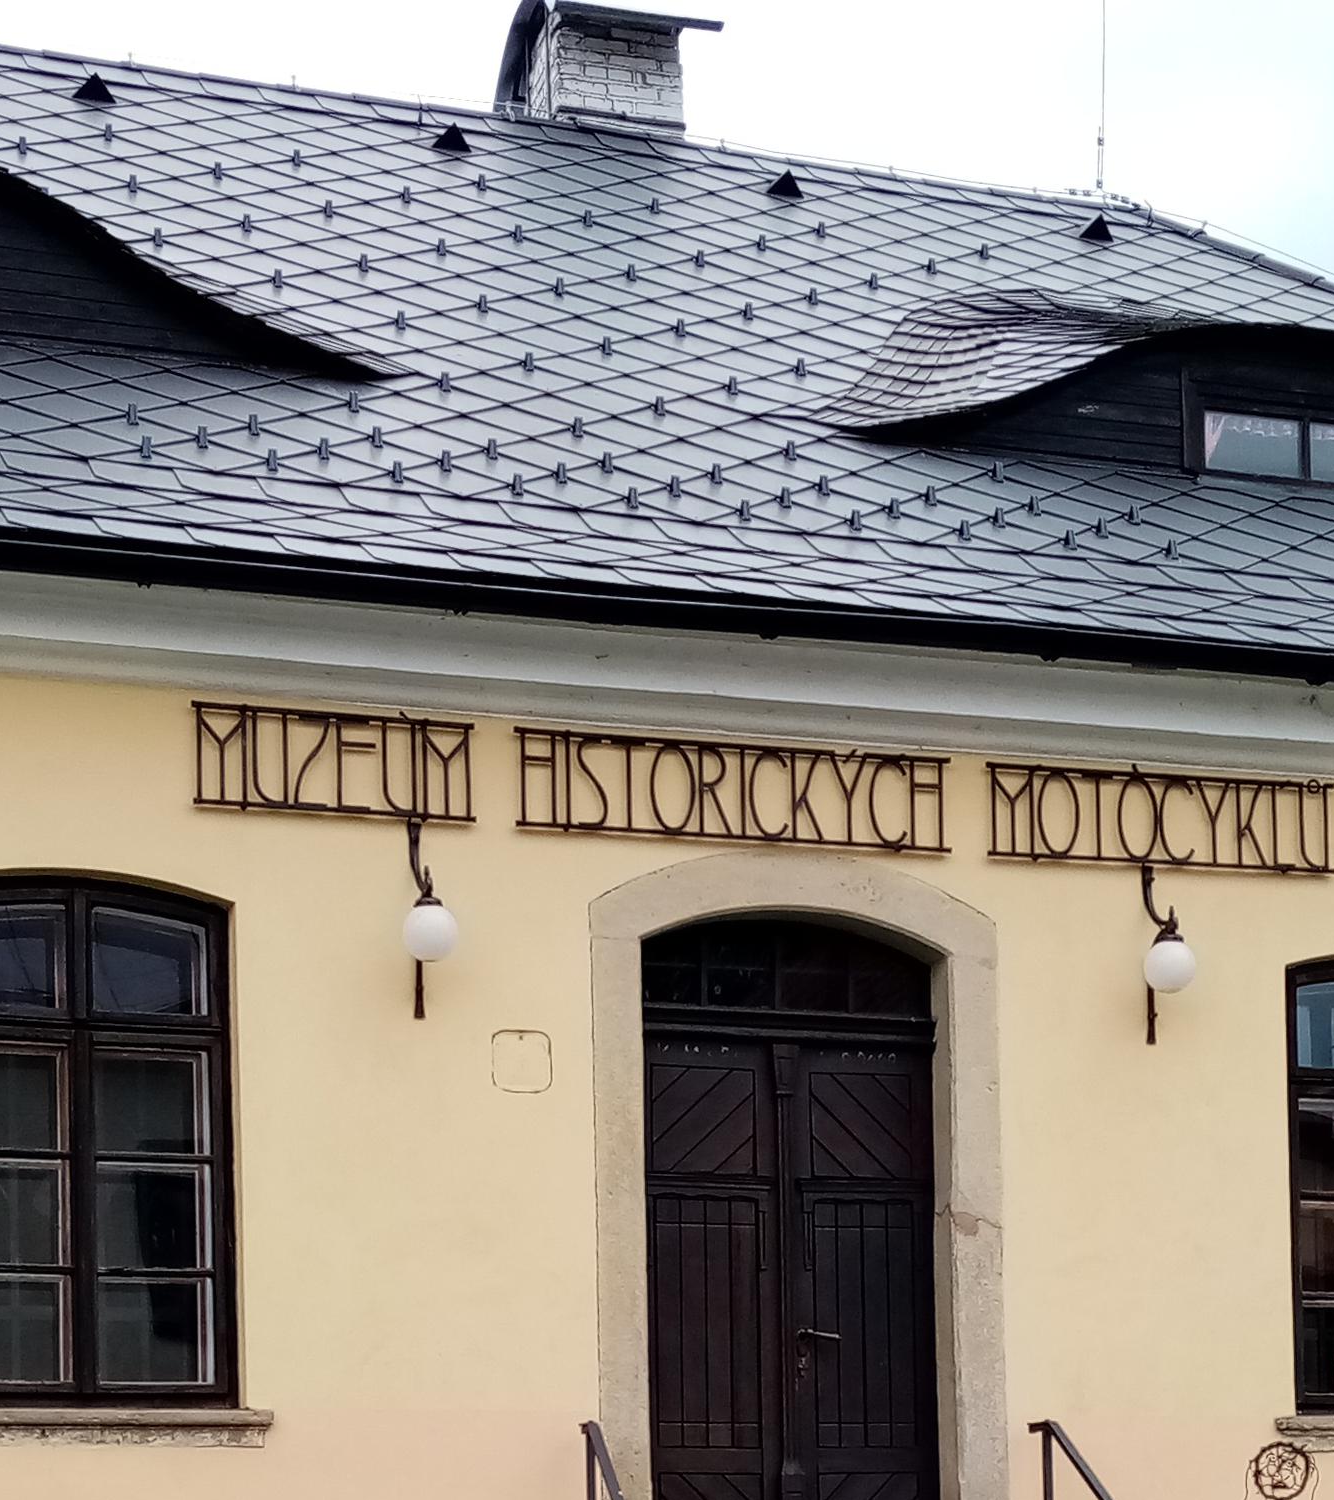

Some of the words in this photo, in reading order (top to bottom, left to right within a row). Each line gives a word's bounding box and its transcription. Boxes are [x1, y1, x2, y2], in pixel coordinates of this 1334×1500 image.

[193, 702, 475, 822] MUZEUM
[515, 727, 950, 851] HISTORICKÝCH
[987, 763, 1334, 873] MOTOCYKLŮ
